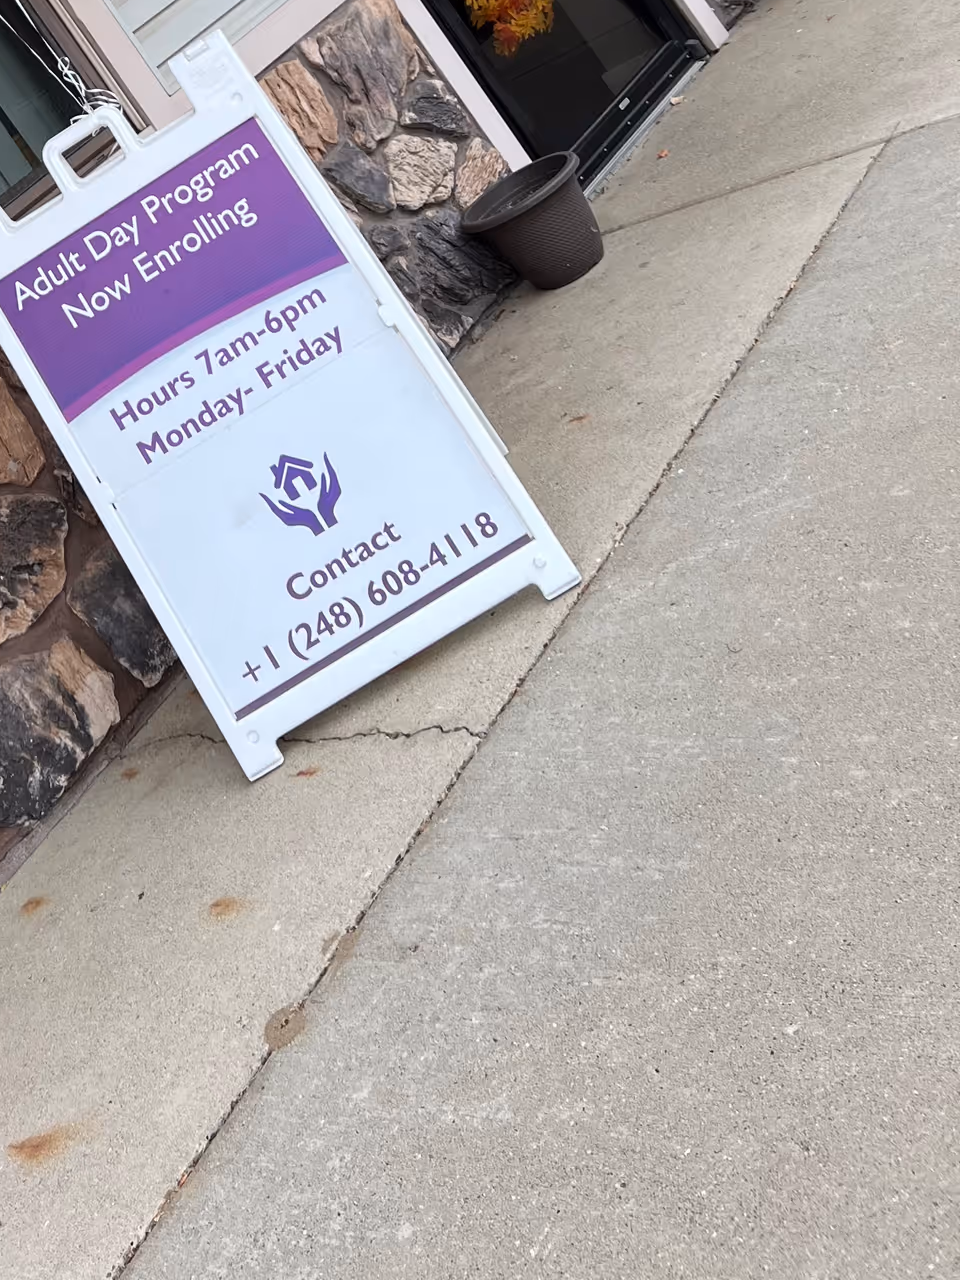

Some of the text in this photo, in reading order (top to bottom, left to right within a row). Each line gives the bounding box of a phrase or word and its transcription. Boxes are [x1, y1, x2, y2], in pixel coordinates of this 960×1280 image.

[14, 143, 259, 311] Adult Day Program
[61, 198, 258, 329] Now Enrolling
[109, 288, 326, 431] Hours 7am-6pm
[136, 325, 343, 465] Monday- Friday
[286, 521, 402, 600] Contact
[287, 596, 364, 661] (248)
[367, 512, 498, 606] 608-4118
